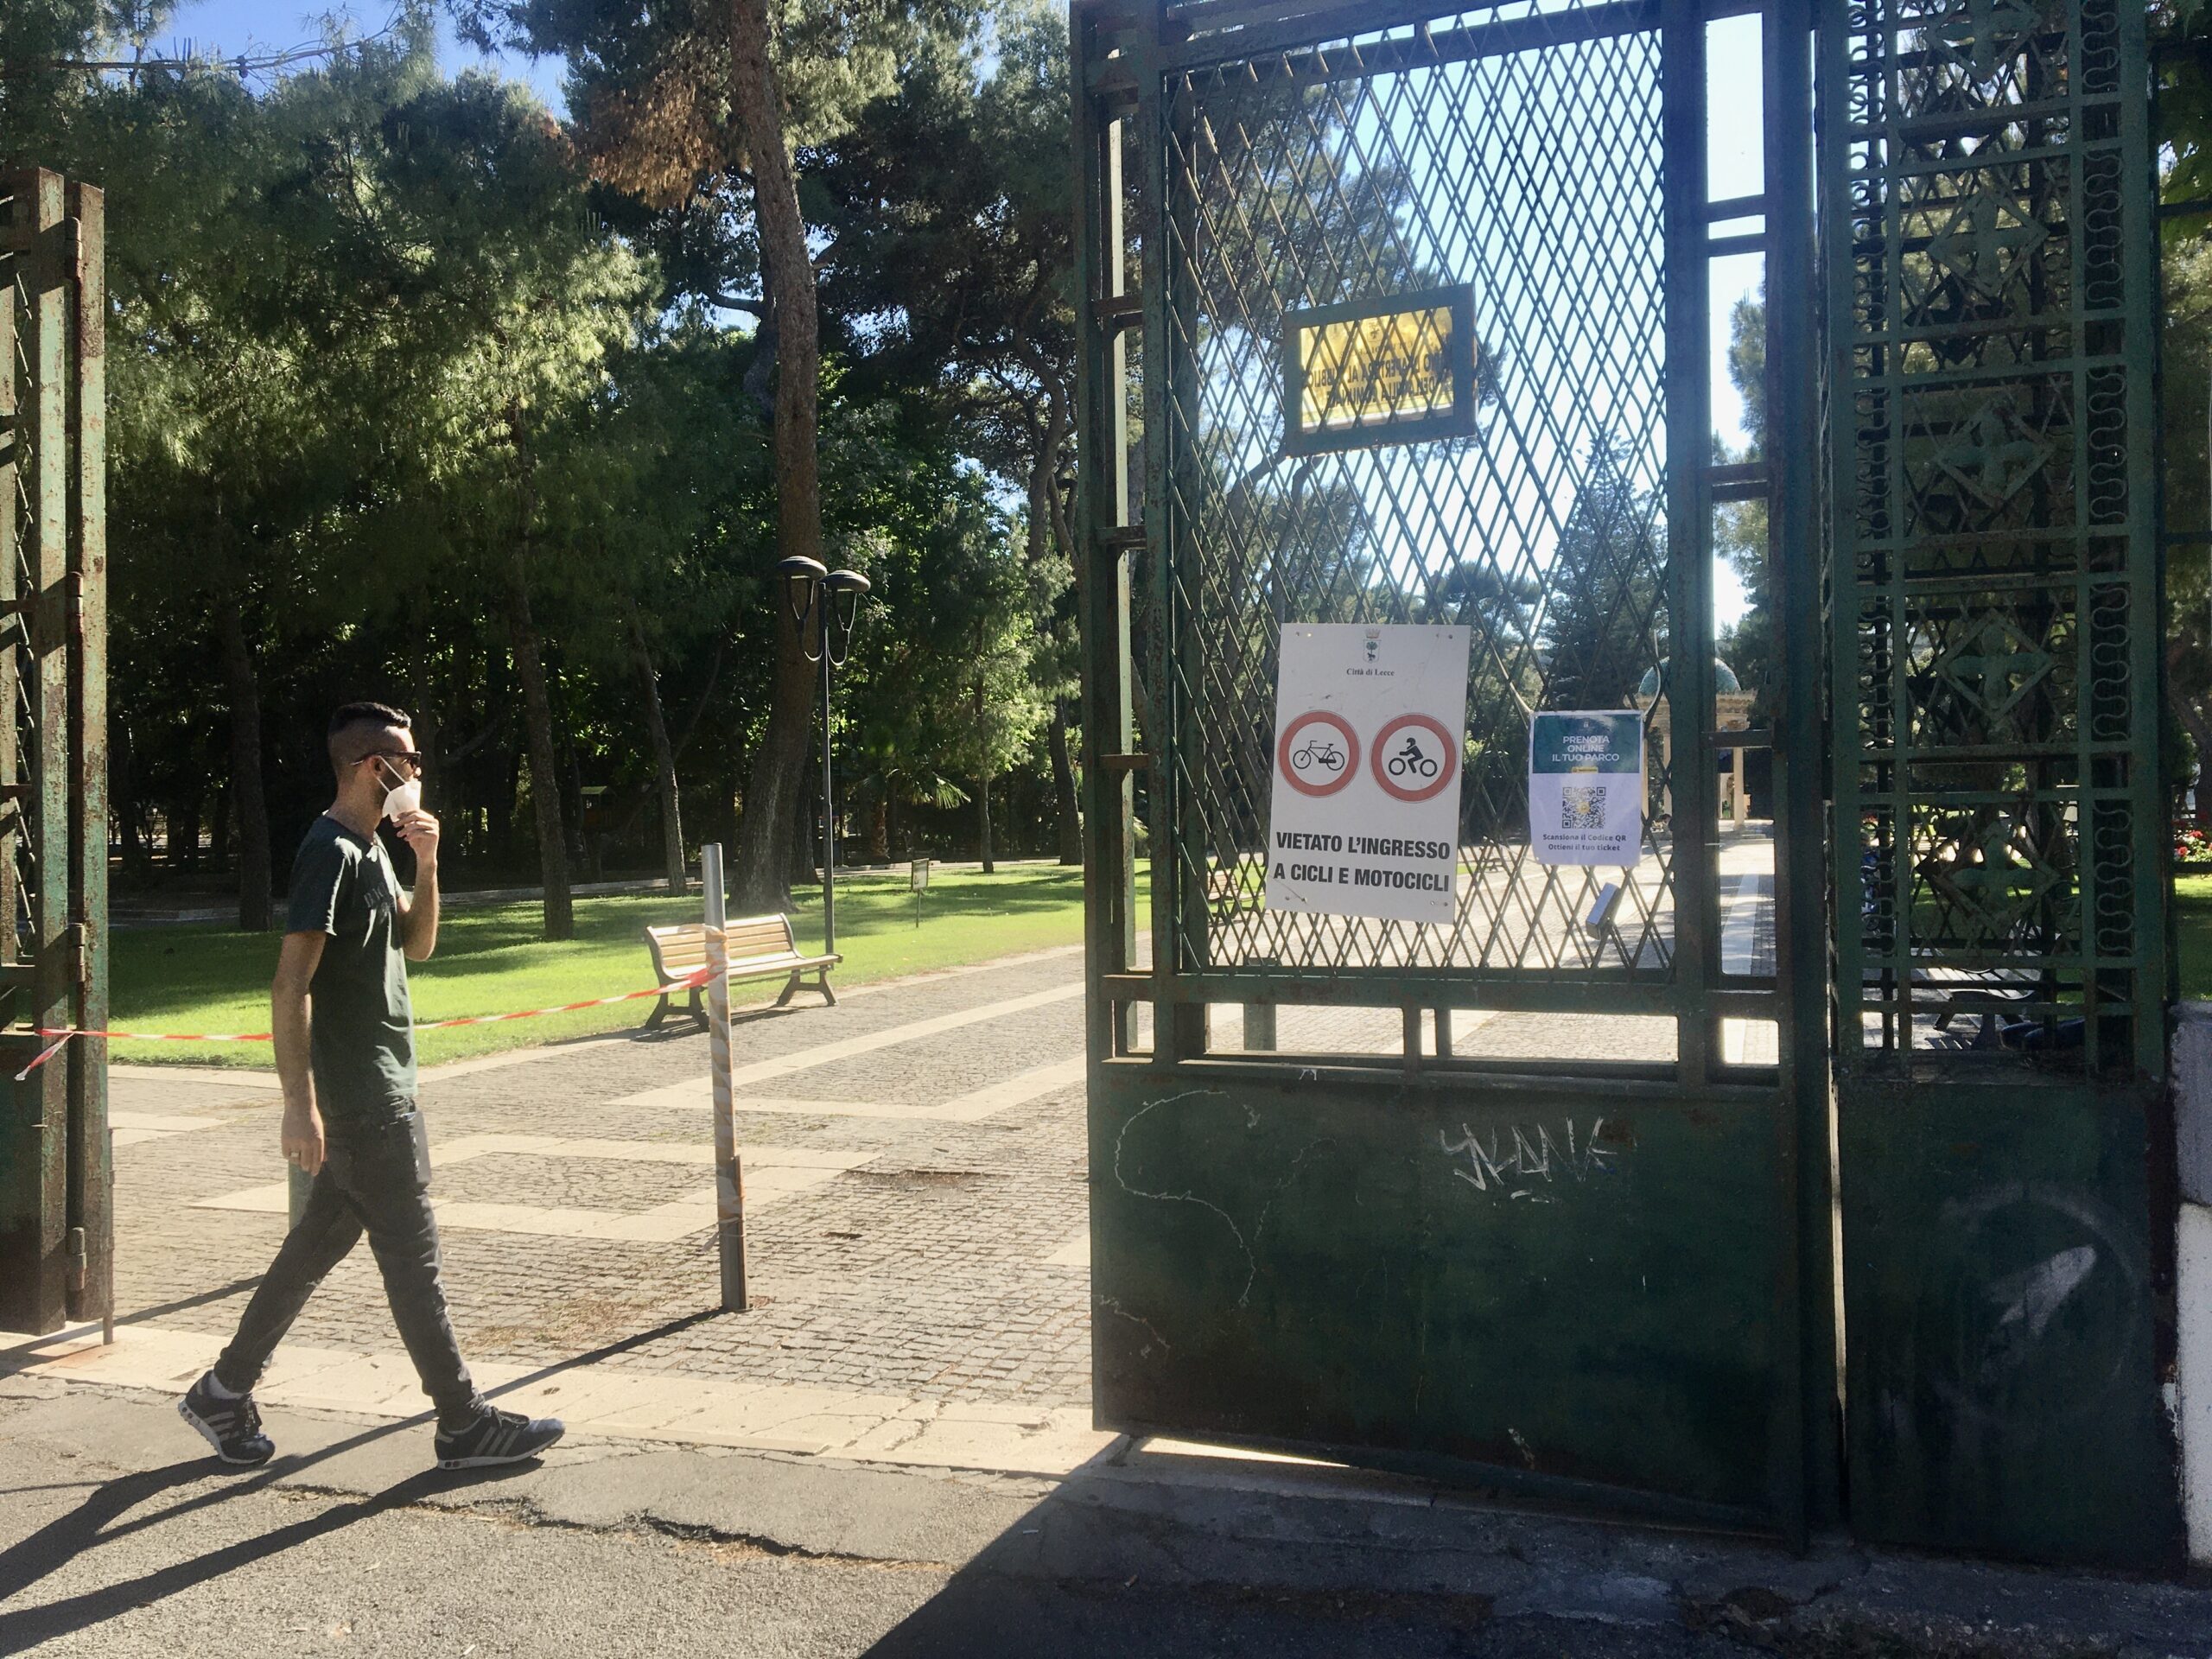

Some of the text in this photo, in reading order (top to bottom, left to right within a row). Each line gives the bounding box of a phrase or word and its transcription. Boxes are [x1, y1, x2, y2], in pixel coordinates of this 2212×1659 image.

[1562, 735, 1610, 744] PRENOTA
[1567, 744, 1605, 753] ONLINE
[1552, 753, 1619, 762] IL TUO PARCO
[1276, 832, 1451, 860] VIETATO L'INGRESSO
[1274, 863, 1450, 893] A CICLI E MOTOCICLI
